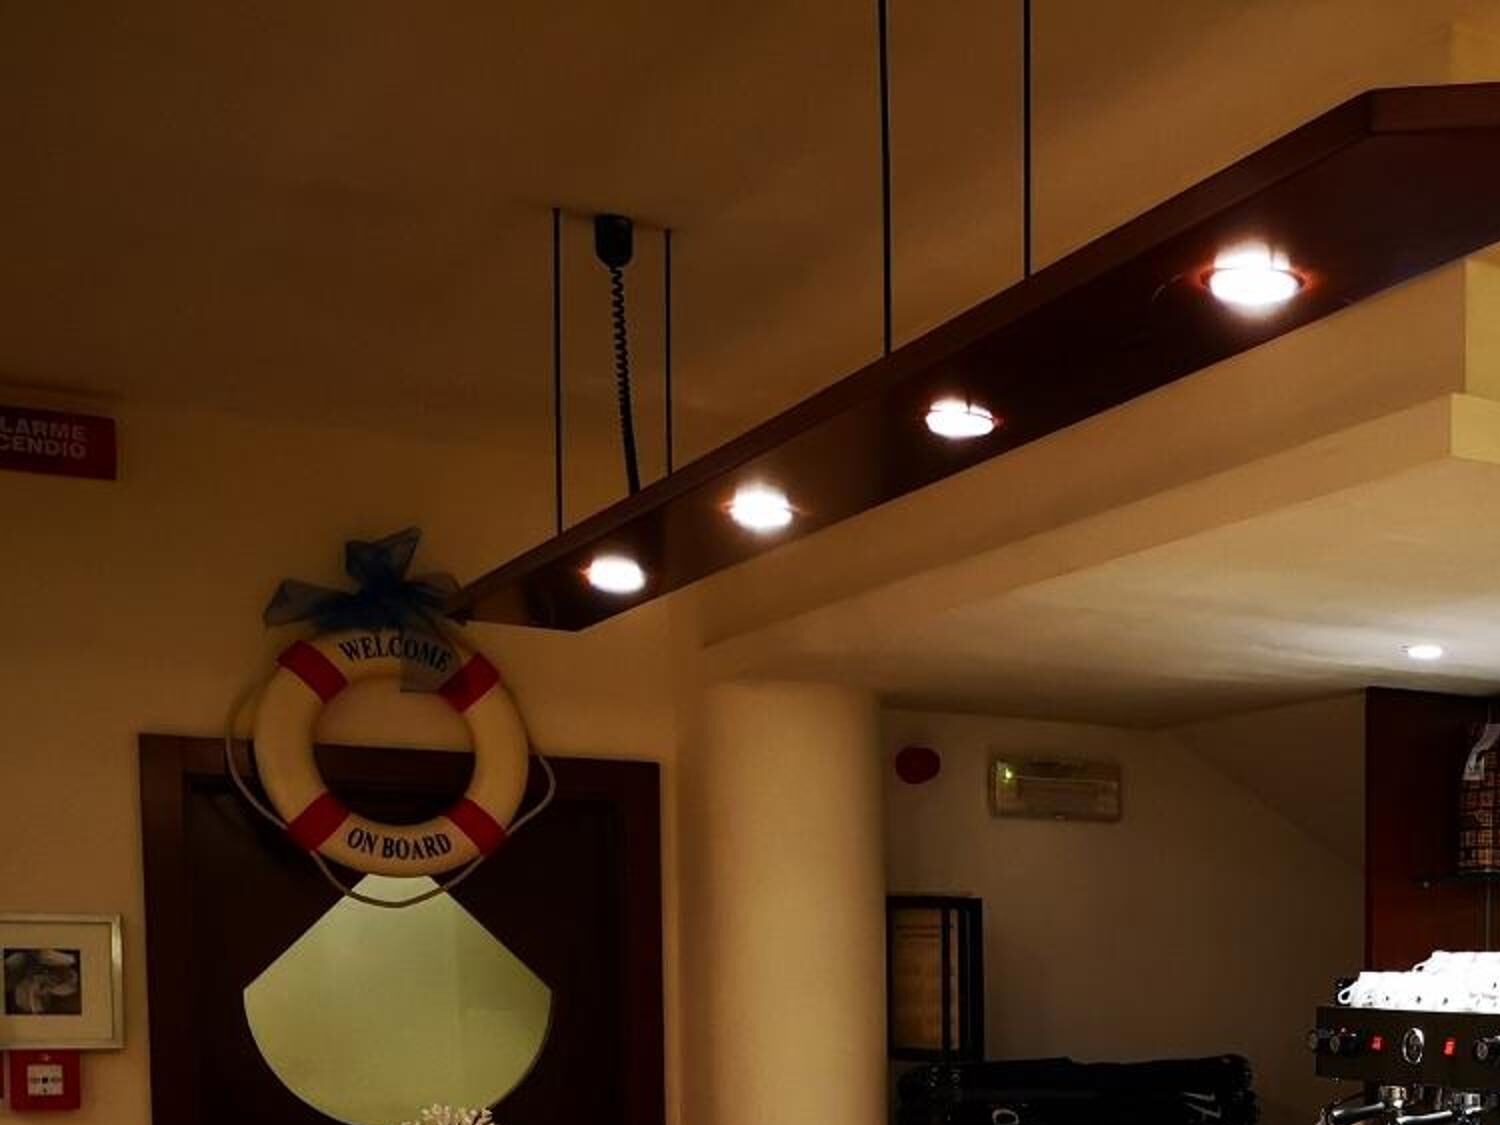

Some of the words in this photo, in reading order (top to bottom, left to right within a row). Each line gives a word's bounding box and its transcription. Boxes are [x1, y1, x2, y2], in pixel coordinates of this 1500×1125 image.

[338, 634, 452, 672] WELCOME
[347, 827, 378, 856] ON
[382, 833, 452, 860] BOARD
